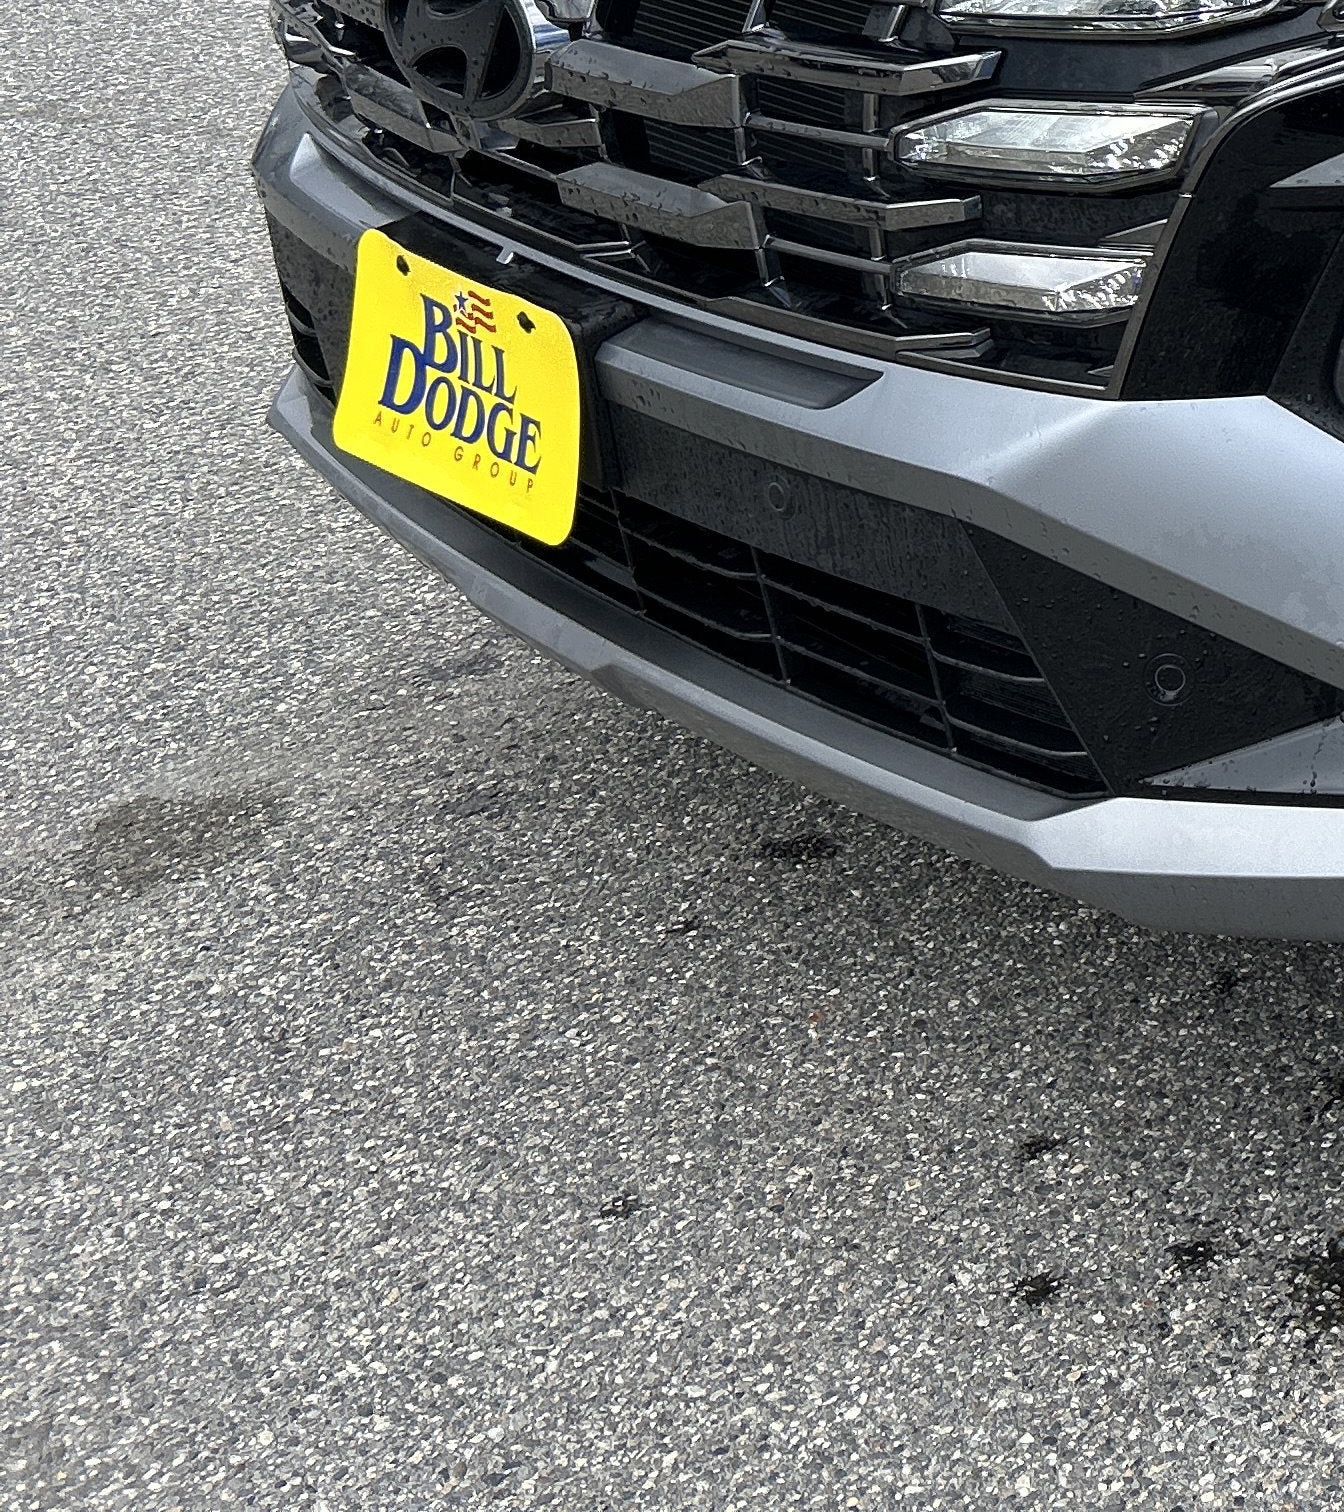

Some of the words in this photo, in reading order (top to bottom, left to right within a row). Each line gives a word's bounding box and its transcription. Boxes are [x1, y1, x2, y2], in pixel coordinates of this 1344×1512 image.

[378, 334, 542, 474] DODGE
[420, 293, 517, 405] BILL
[374, 410, 431, 447] AUTO
[454, 445, 535, 492] GROUP
